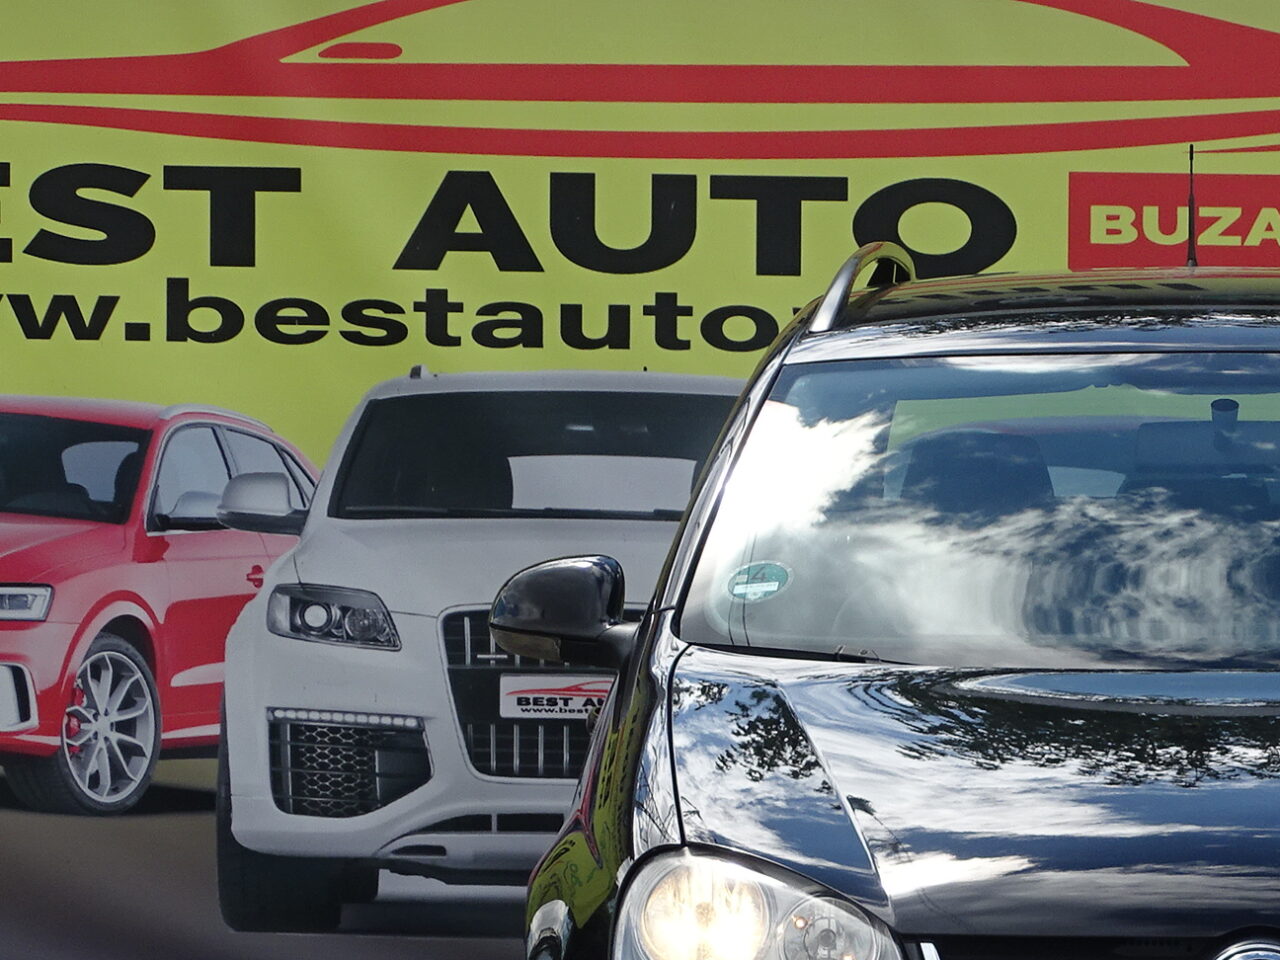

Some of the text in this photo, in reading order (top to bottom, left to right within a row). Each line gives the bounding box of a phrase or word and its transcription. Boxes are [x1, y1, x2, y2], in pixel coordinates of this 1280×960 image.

[0, 162, 1018, 278] ST AUTO
[0, 277, 801, 353] w.bestauto
[516, 696, 573, 707] BEST
[520, 706, 589, 714] www.best
